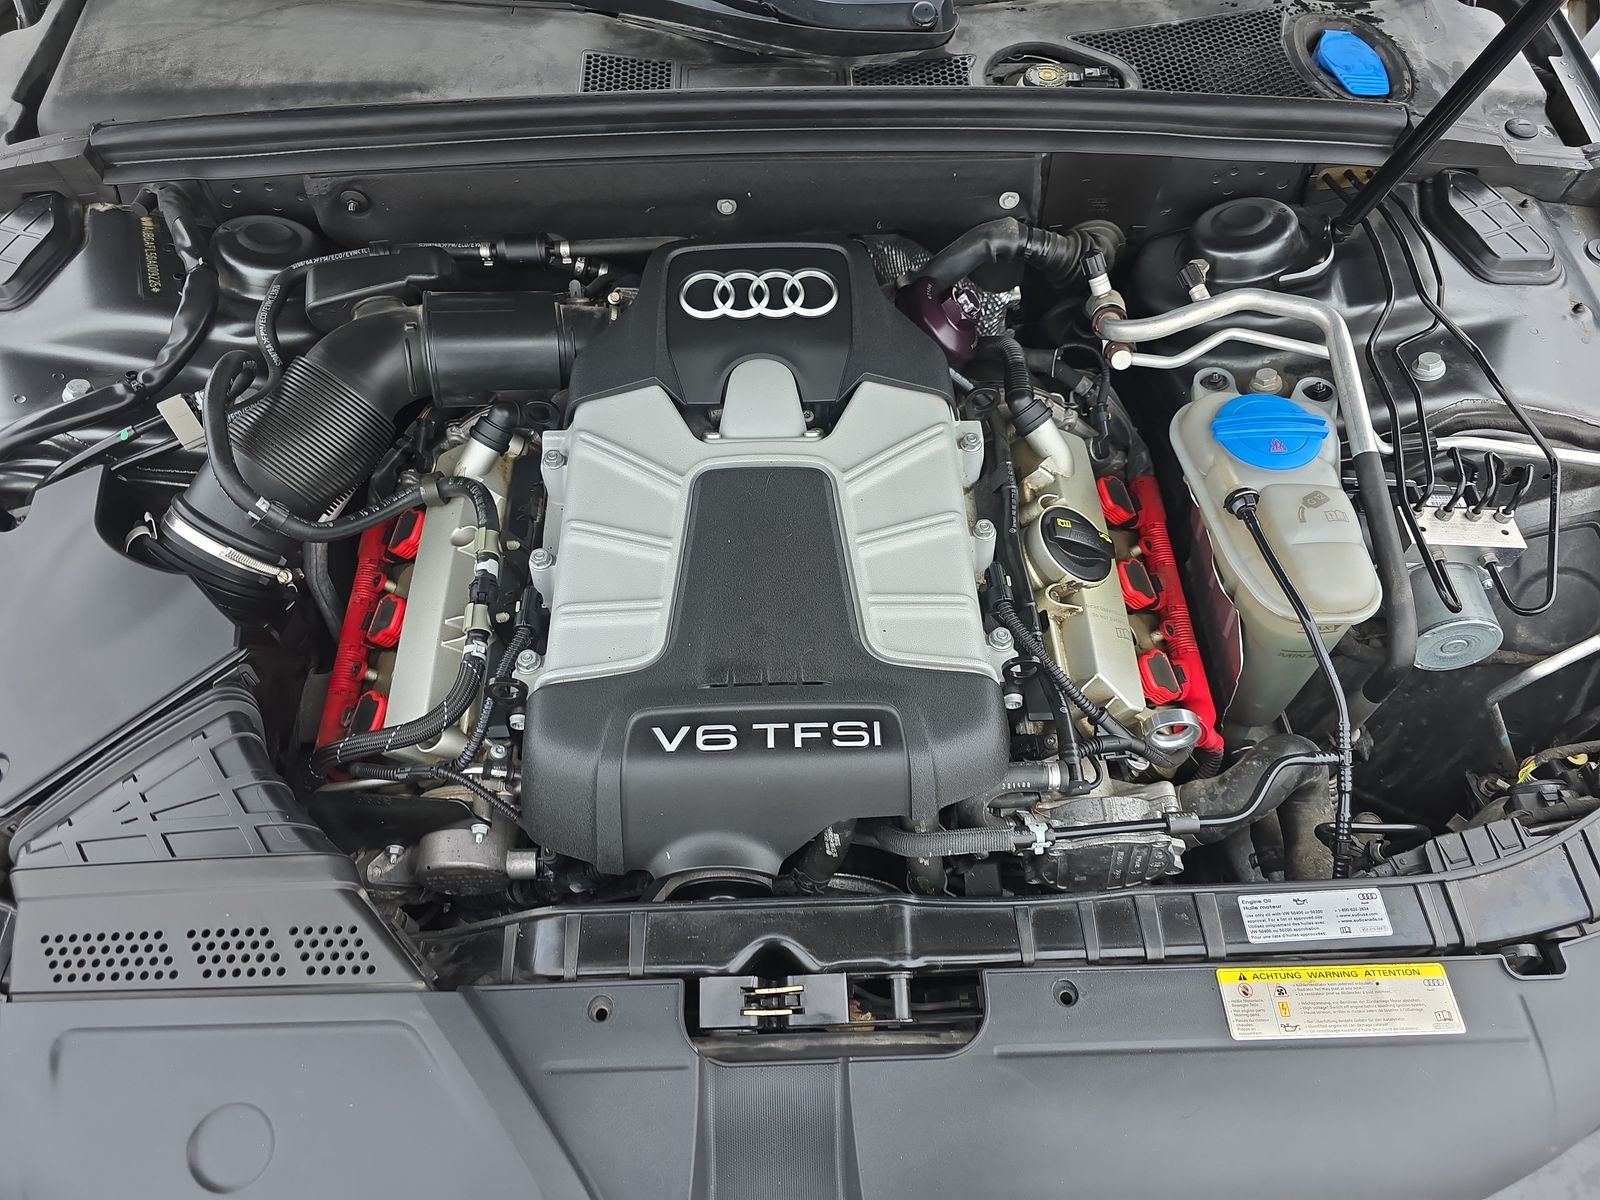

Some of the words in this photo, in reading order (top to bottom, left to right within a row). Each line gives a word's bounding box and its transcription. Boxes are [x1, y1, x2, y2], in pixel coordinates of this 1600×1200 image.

[651, 724, 739, 753] V6
[752, 720, 882, 749] TFSI
[1252, 971, 1302, 980] ACHTUNG
[1306, 970, 1359, 979] WARNING
[1364, 968, 1421, 977] ATTENTION
